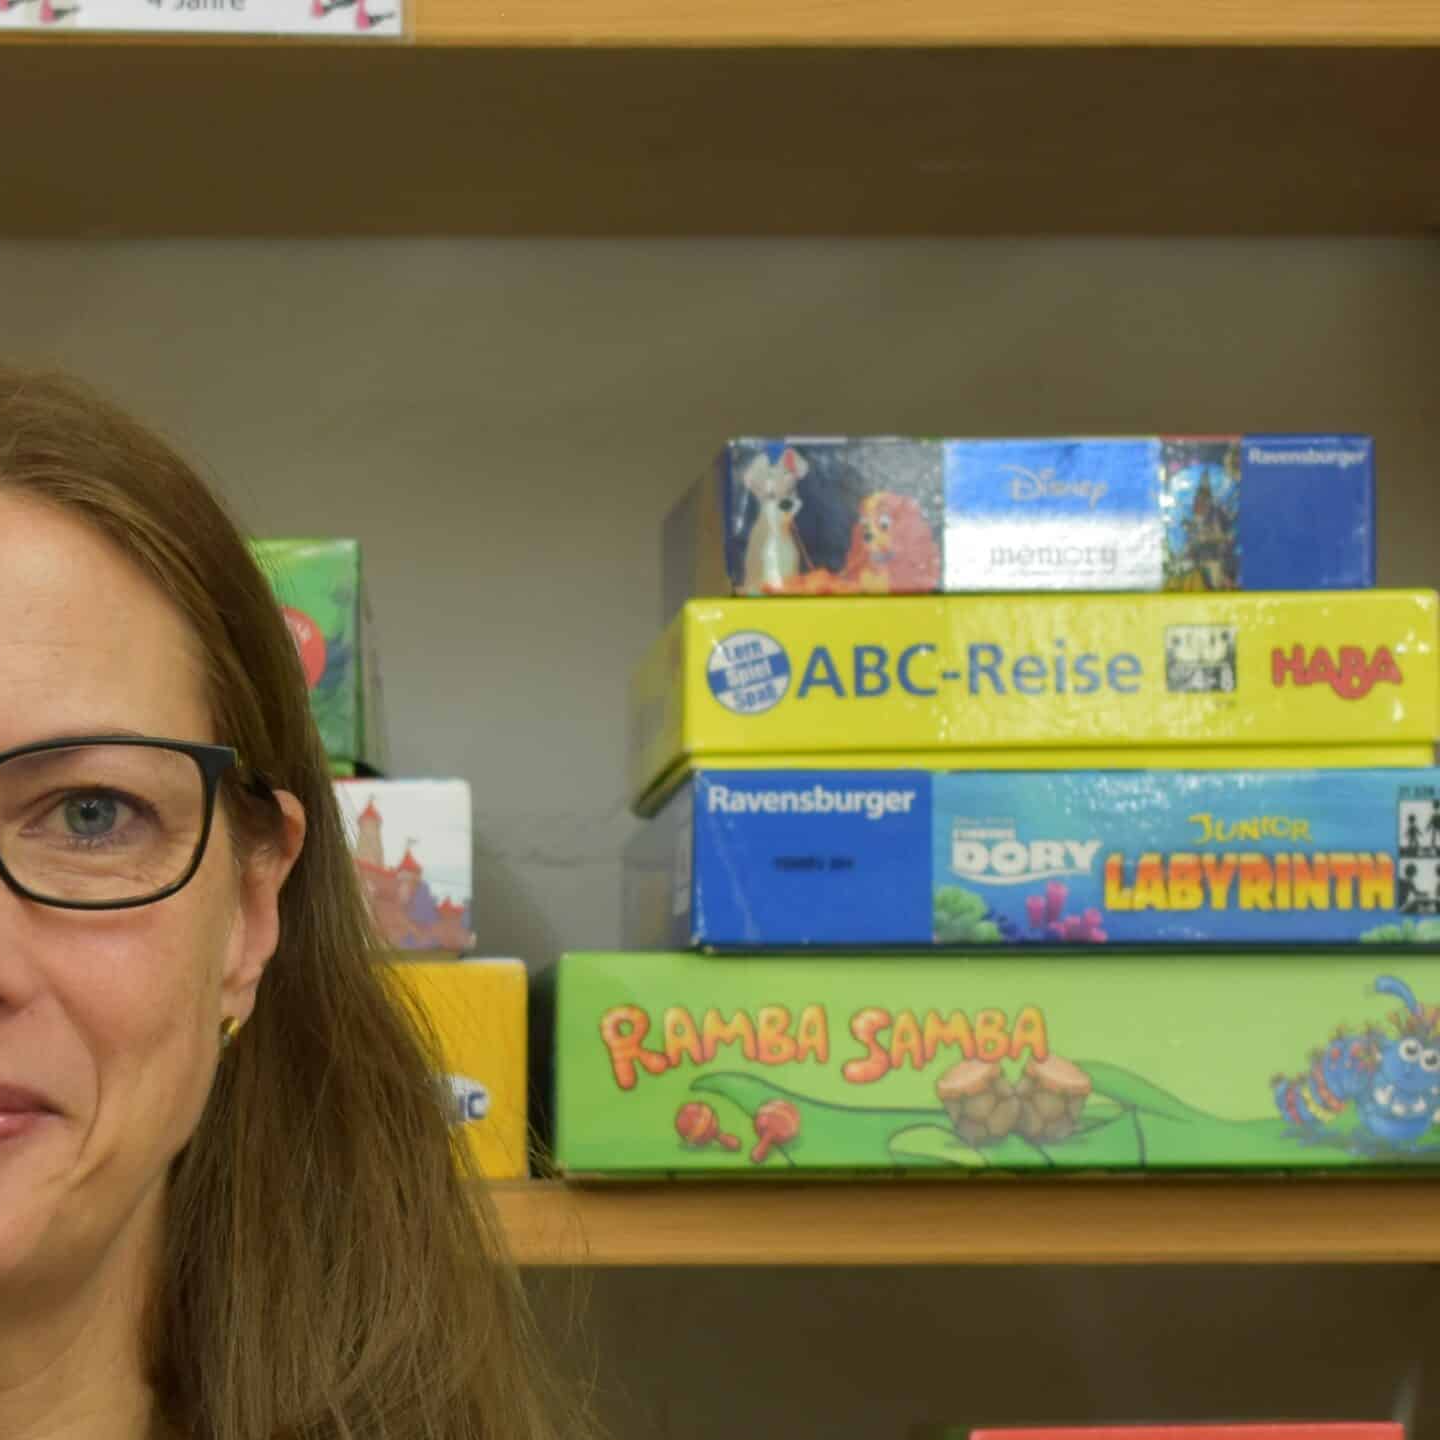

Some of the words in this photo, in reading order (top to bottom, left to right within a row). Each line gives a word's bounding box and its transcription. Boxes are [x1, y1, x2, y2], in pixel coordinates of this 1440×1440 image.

[1247, 448, 1368, 469] Ravensburger
[989, 542, 1119, 571] memory
[797, 643, 1144, 699] ABC-Reise
[1271, 644, 1404, 700] HABA
[706, 785, 915, 818] Ravensburger
[1187, 813, 1313, 845] JUNIOR
[953, 840, 1103, 876] DORY
[1104, 851, 1397, 912] LABYRINTH
[598, 1003, 831, 1091] RAMBA
[842, 1005, 1050, 1084] SAMBA
